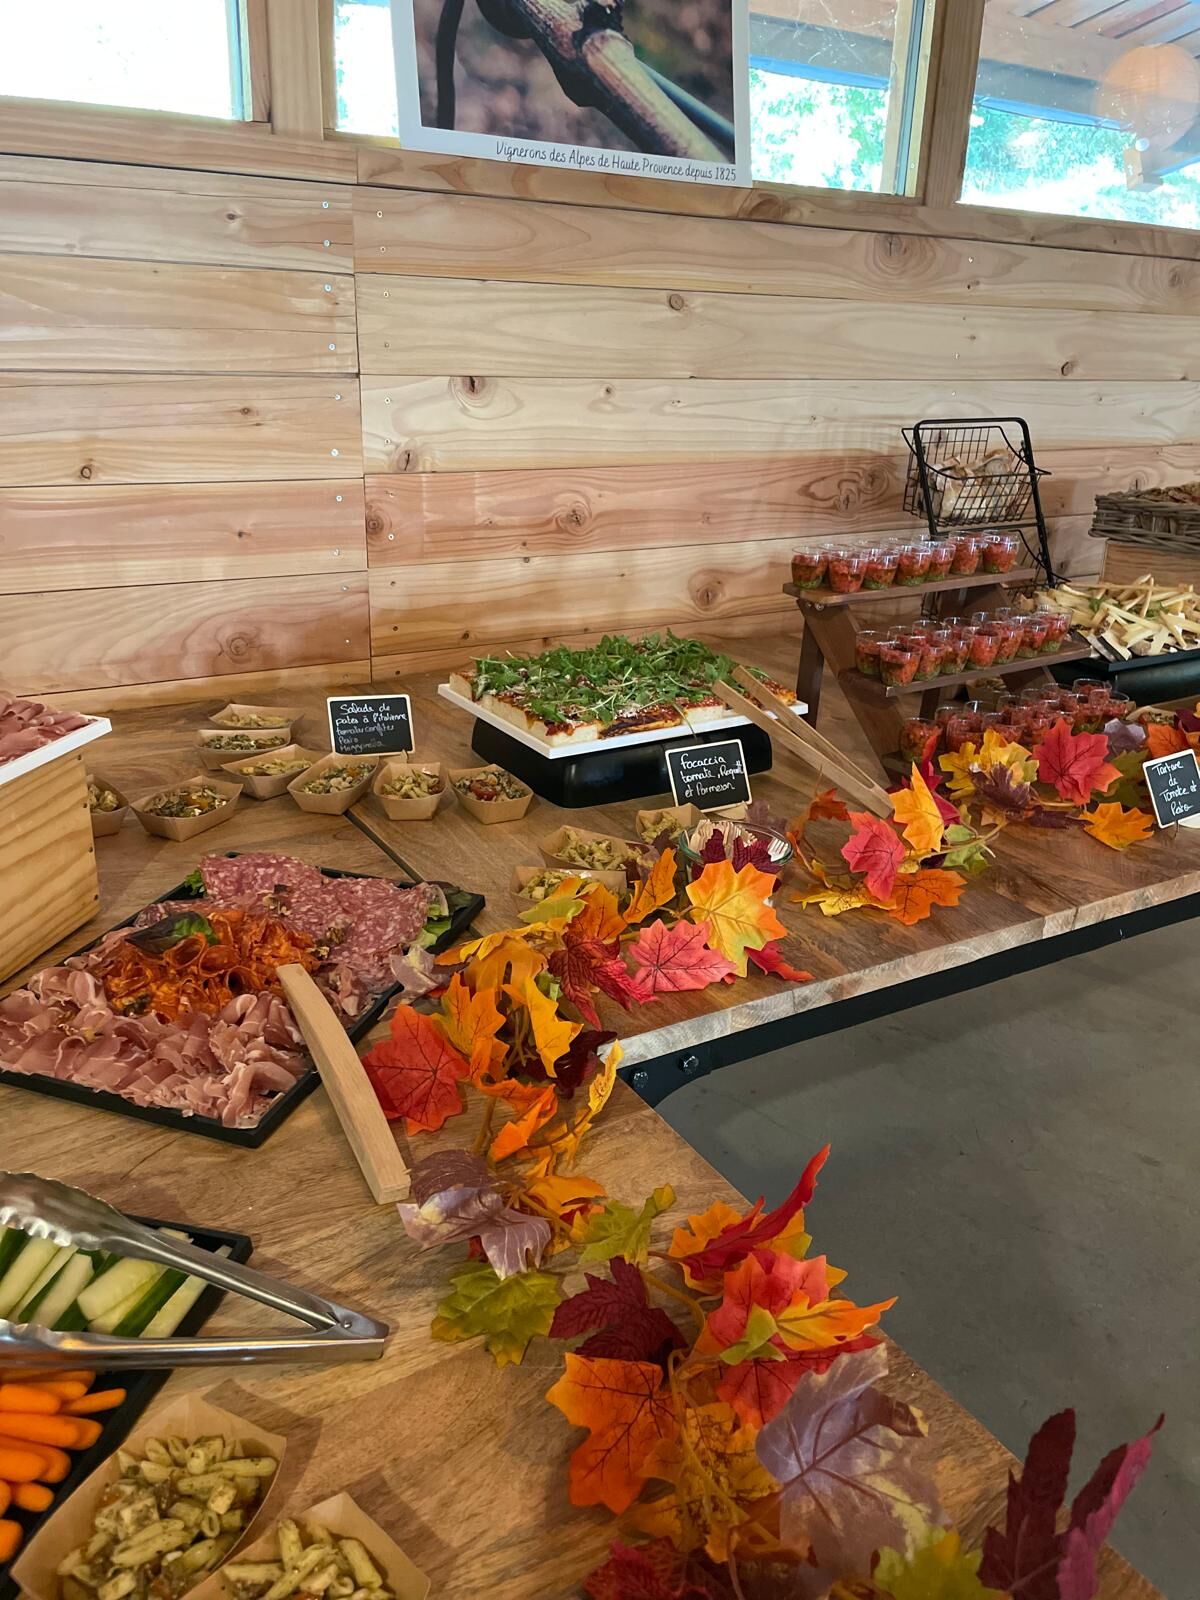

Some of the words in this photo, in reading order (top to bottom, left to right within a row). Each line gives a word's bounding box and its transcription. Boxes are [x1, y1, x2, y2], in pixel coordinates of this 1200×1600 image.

[496, 141, 547, 161] Vignerons
[549, 148, 567, 163] des
[568, 149, 596, 168] Alpes
[597, 154, 610, 168] de
[612, 155, 640, 171] Haute
[642, 157, 684, 176] Provence
[685, 165, 713, 181] depuis
[715, 167, 737, 181] 1825
[379, 702, 390, 712] de
[1168, 773, 1179, 787] de
[684, 784, 694, 798] et
